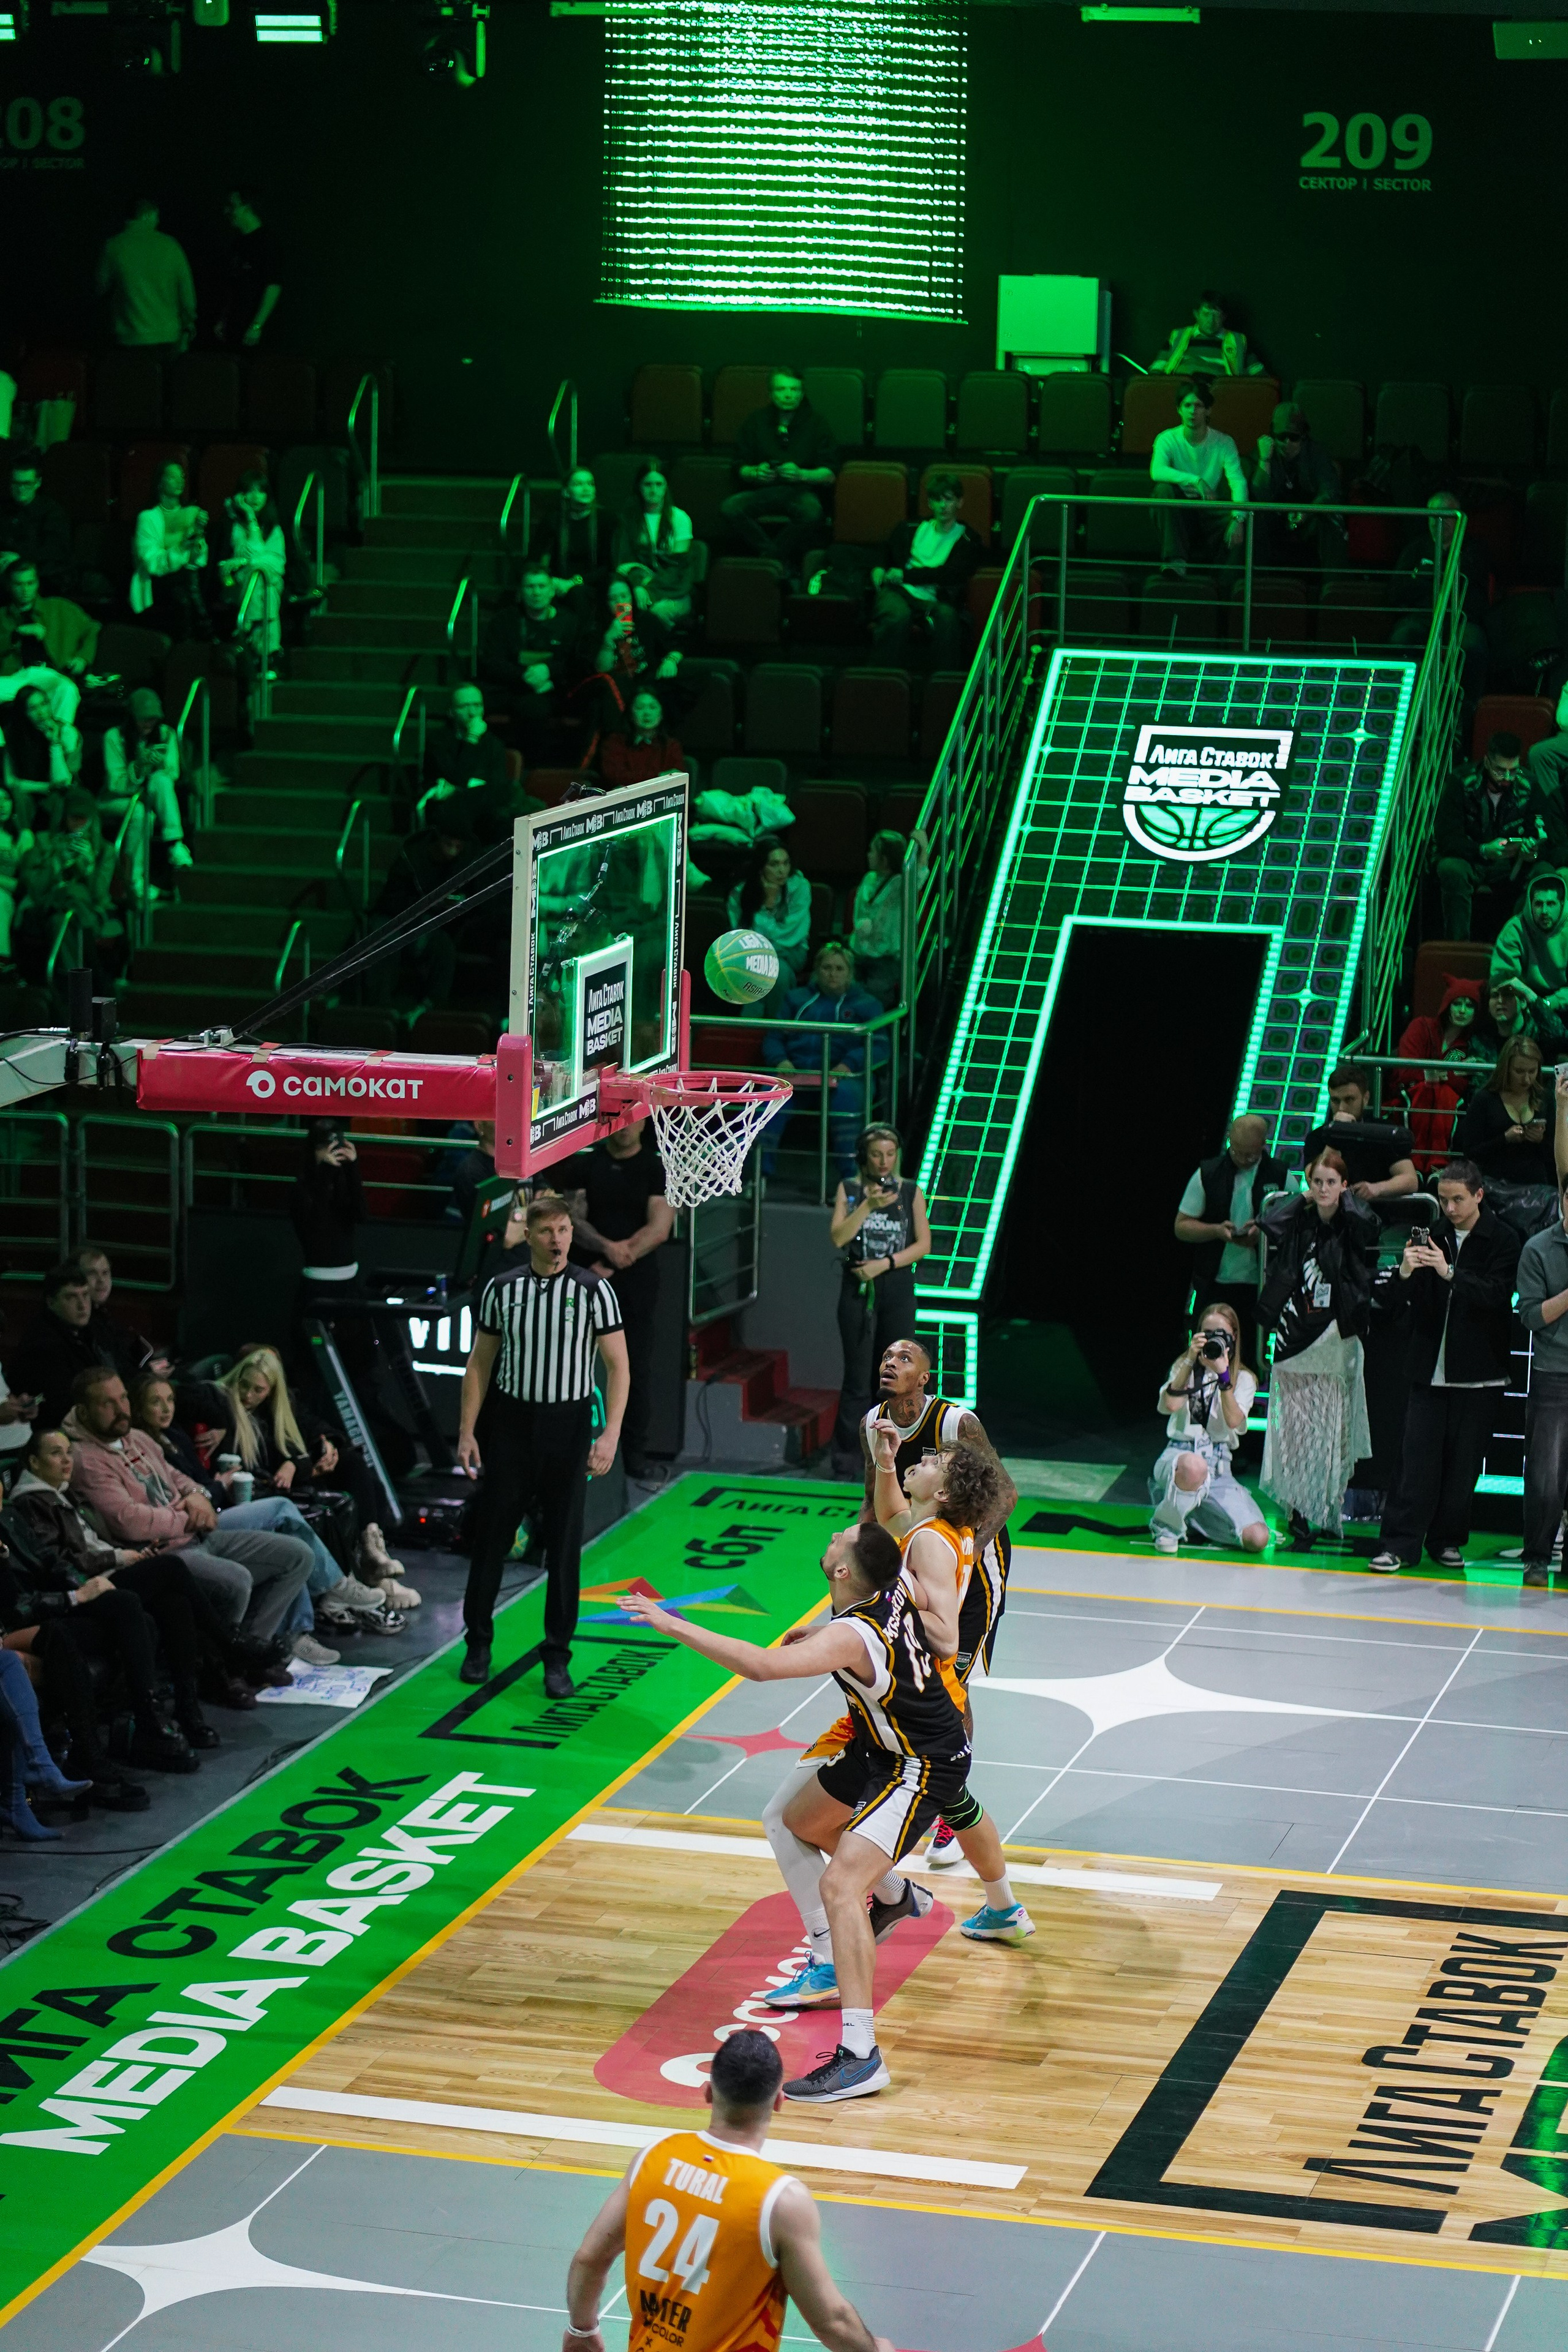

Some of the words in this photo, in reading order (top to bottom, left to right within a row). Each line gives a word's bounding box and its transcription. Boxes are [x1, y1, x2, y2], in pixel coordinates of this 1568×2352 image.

[0, 96, 85, 151] 08
[1300, 111, 1433, 170] 209
[1298, 176, 1358, 190] СЕКТОР
[1373, 178, 1433, 192] SECTOR
[1124, 785, 1281, 807] BASKET
[1128, 766, 1281, 791] MEDIA
[745, 954, 768, 977] MEDIA
[587, 1005, 623, 1038] MEDIA
[587, 1026, 623, 1056] BASKET
[283, 1076, 423, 1099] самокат
[0, 1983, 162, 2105] ИГА
[106, 1766, 432, 1959] СТАВОК
[0, 1977, 310, 2155] MEDIA
[227, 1771, 537, 1967] BASKET
[1361, 1932, 1568, 2079] СТАВОК
[1303, 2086, 1502, 2195] ЛИГА
[663, 2157, 729, 2205] TURAL
[639, 2198, 720, 2295] 24
[650, 2322, 685, 2348] COLOR
